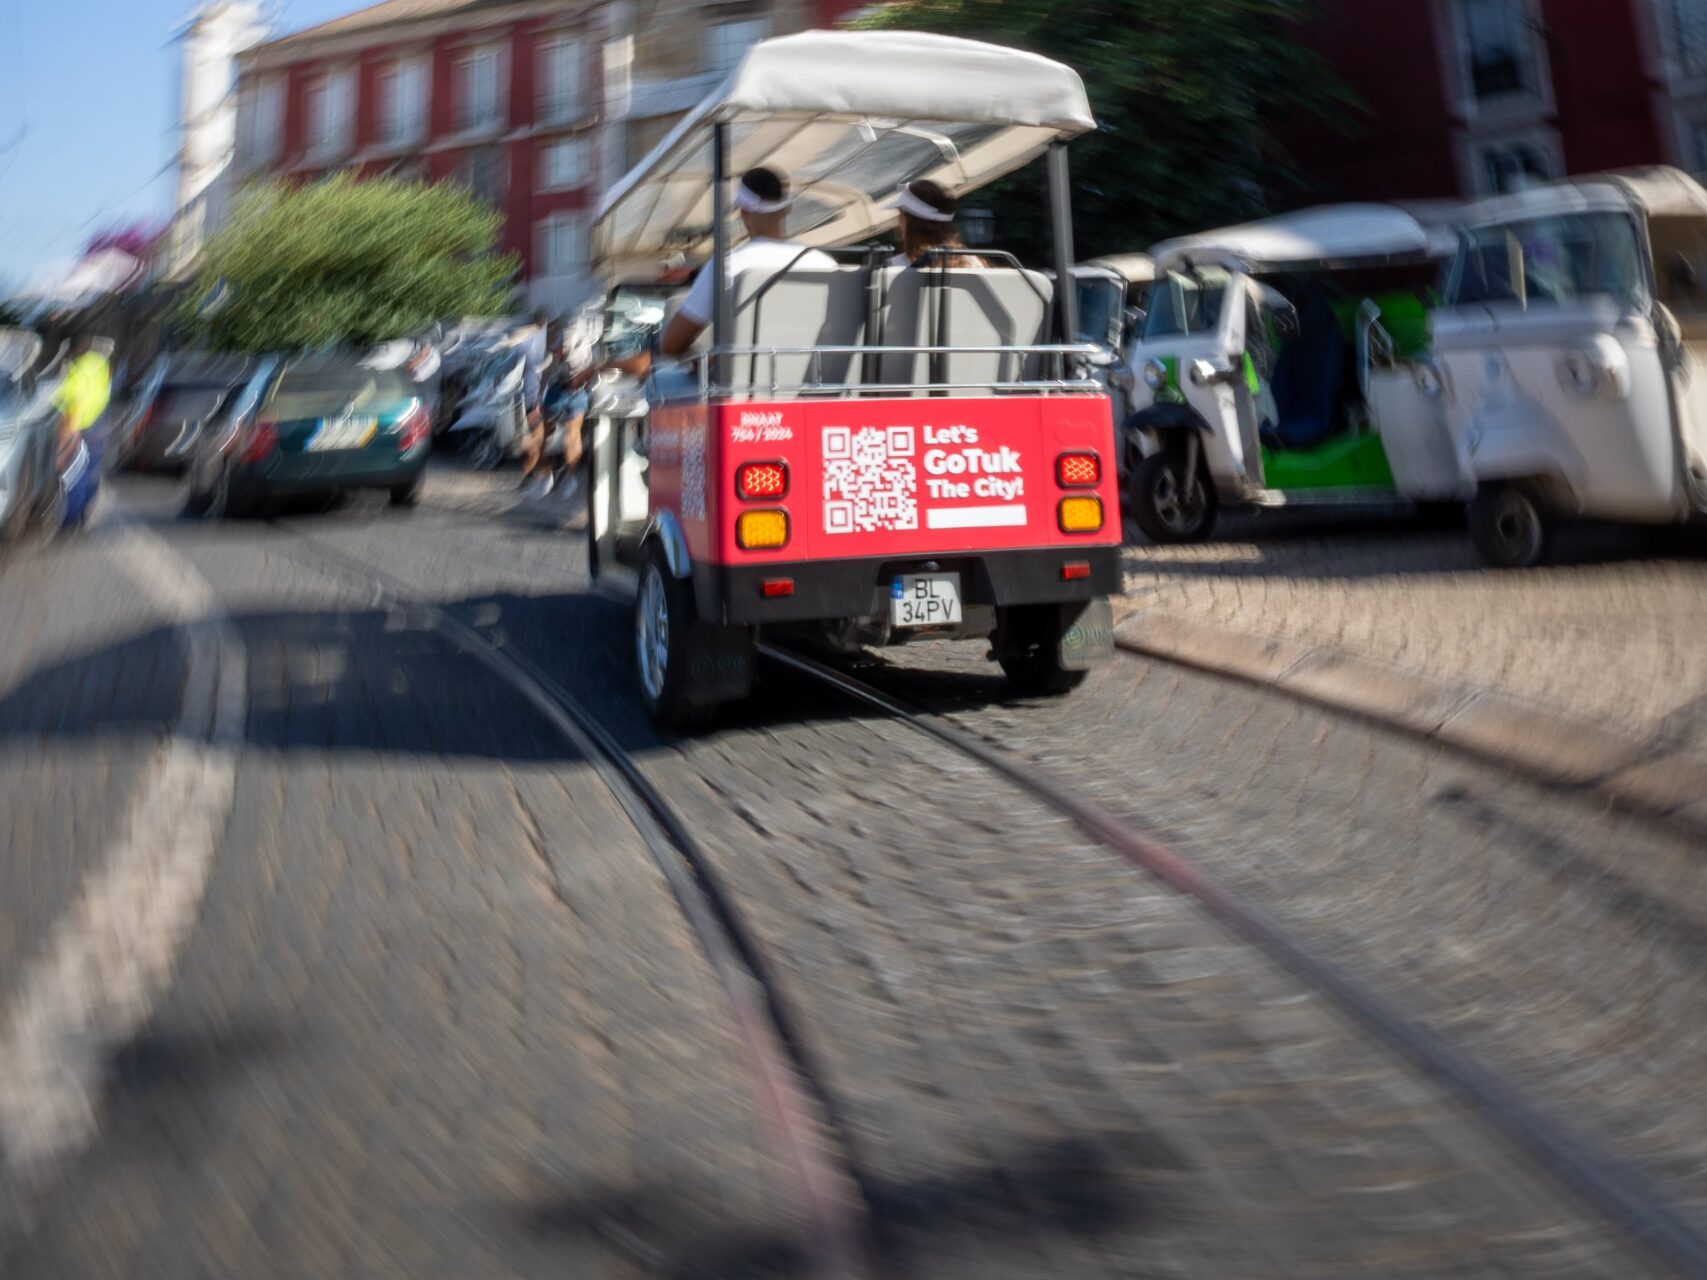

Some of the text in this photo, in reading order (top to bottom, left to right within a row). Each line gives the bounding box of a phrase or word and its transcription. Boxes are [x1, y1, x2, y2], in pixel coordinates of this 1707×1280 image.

[923, 425, 978, 444] Let's
[924, 447, 1022, 474] GoTuk
[926, 475, 1024, 500] The City!
[915, 578, 940, 599] BL
[903, 600, 953, 623] 34PV
